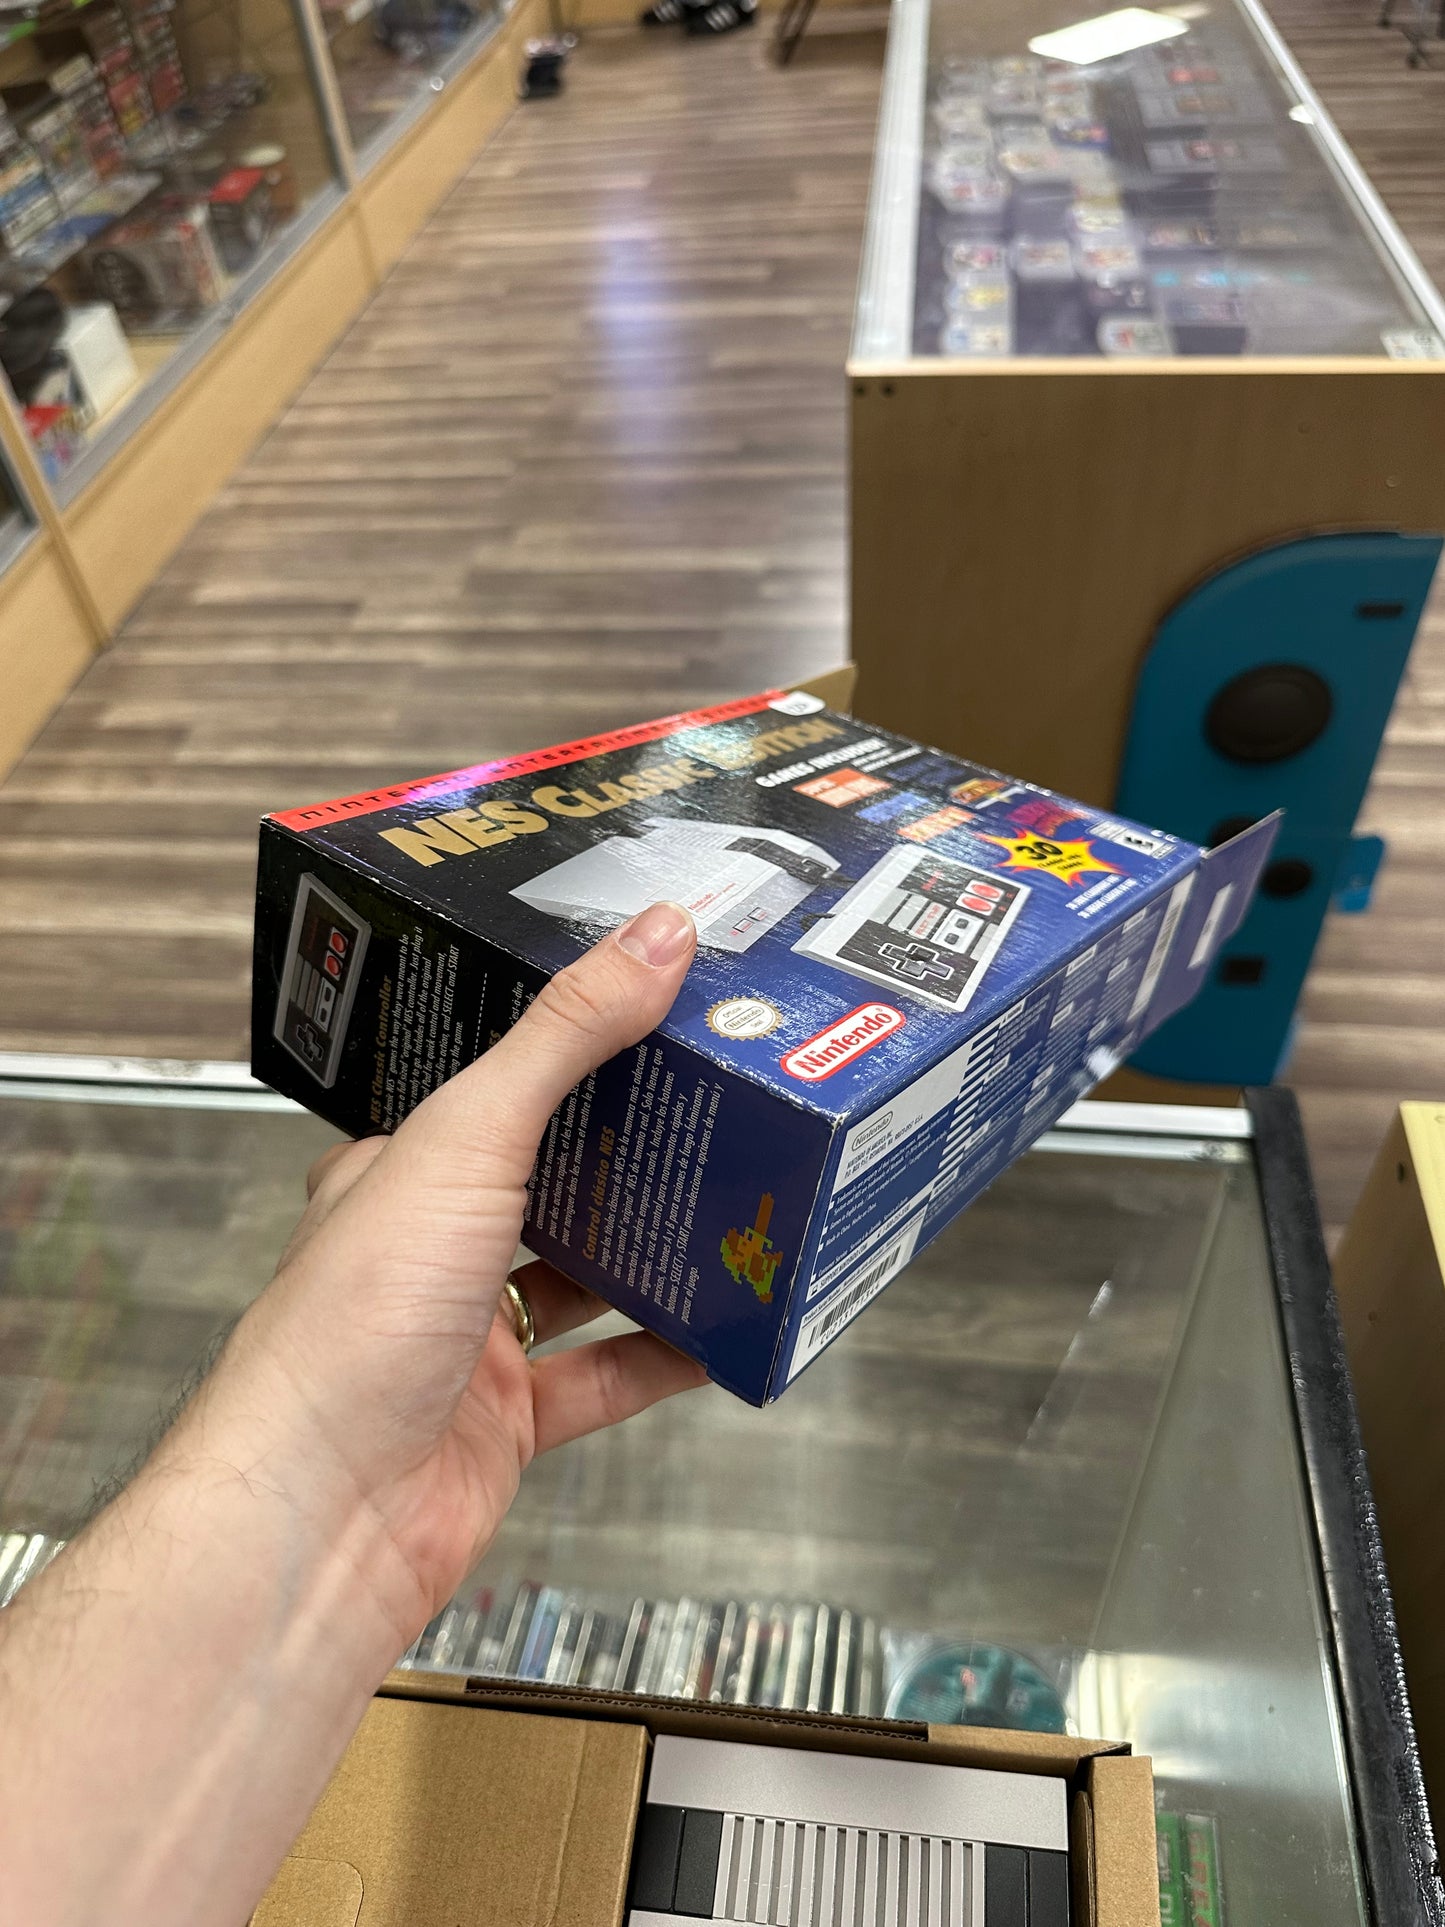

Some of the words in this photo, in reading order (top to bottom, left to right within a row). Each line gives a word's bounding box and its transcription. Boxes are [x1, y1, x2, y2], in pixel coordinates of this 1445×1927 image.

[379, 801, 549, 867] NES
[1015, 841, 1064, 861] 30
[398, 934, 409, 945] be
[399, 945, 407, 954] to
[410, 934, 423, 954] plug
[398, 954, 406, 980] meant
[409, 952, 419, 970] Just
[447, 944, 459, 970] START
[421, 956, 432, 988] original
[434, 952, 447, 997] movement,
[446, 968, 456, 987] and
[396, 981, 404, 1000] were
[407, 972, 417, 1008] controller.
[417, 989, 428, 1002] the
[442, 985, 453, 1014] SELECT
[376, 975, 391, 1047] Controller
[391, 1000, 403, 1018] they
[416, 1001, 426, 1012] of
[430, 993, 440, 1011] and
[392, 1018, 402, 1034] way
[403, 1007, 413, 1024] NES
[415, 1011, 425, 1024] all
[428, 1009, 438, 1038] control
[441, 1013, 450, 1030] and
[388, 1035, 398, 1048] the
[412, 1024, 424, 1054] Includes
[454, 1021, 463, 1045] game.
[425, 1038, 435, 1059] quick
[439, 1033, 450, 1057] action,
[449, 1044, 460, 1058] the
[389, 1049, 397, 1074] games
[422, 1059, 432, 1072] for
[632, 1044, 648, 1090] adecuada
[653, 1048, 663, 1065] que
[372, 1051, 385, 1095] Classic
[399, 1059, 408, 1081] sized
[411, 1068, 419, 1077] to
[421, 1070, 431, 1087] Pad
[646, 1066, 659, 1091] tienes
[396, 1079, 406, 1094] full
[409, 1077, 420, 1099] ready
[584, 1073, 595, 1093] jeu
[629, 1084, 639, 1103] más
[657, 1071, 674, 1104] botones
[383, 1093, 393, 1115] classic
[581, 1092, 592, 1101] le
[641, 1091, 654, 1110] Solo
[708, 1090, 720, 1116] menú
[370, 1097, 381, 1123] NES
[562, 1090, 576, 1127] boutons
[580, 1101, 590, 1128] mettre
[623, 1103, 635, 1135] manera
[654, 1104, 667, 1118] los
[670, 1101, 684, 1132] rápidos
[684, 1086, 704, 1131] fulminante
[638, 1111, 650, 1130] real.
[702, 1116, 714, 1128] de
[546, 1111, 559, 1164] mouvements
[560, 1127, 571, 1140] les
[577, 1127, 586, 1138] et
[599, 1126, 615, 1156] NES
[618, 1135, 629, 1145] la
[649, 1118, 665, 1147] Incluye
[561, 1139, 569, 1149] et
[574, 1138, 584, 1164] menus
[616, 1145, 627, 1156] de
[632, 1131, 646, 1162] tamaño
[678, 1132, 695, 1157] fuego
[697, 1129, 711, 1164] opciones
[556, 1152, 569, 1180] rapides,
[613, 1155, 625, 1173] NES
[628, 1162, 640, 1173] de
[646, 1150, 658, 1175] usarlo.
[661, 1132, 677, 1183] movimientos
[676, 1157, 688, 1169] de
[540, 1163, 551, 1178] des
[568, 1164, 580, 1176] les
[611, 1173, 622, 1184] de
[625, 1172, 637, 1190] NES
[541, 1177, 549, 1187] et
[552, 1179, 563, 1206] actions
[566, 1176, 578, 1195] dans
[591, 1159, 609, 1206] clásico
[673, 1169, 686, 1202] acciones
[686, 1165, 703, 1209] seleccionar
[639, 1183, 651, 1217] empezar
[657, 1183, 667, 1204] para
[536, 1187, 548, 1229] commandes
[548, 1205, 559, 1219] des
[563, 1195, 575, 1227] naviguer
[652, 1200, 663, 1229] control
[669, 1202, 679, 1223] para
[683, 1208, 693, 1230] para
[548, 1219, 557, 1239] pour
[561, 1227, 570, 1247] pour
[582, 1206, 601, 1259] Control
[617, 1225, 627, 1253] control
[632, 1217, 645, 1245] podrás
[646, 1229, 658, 1241] de
[676, 1226, 689, 1251] START
[600, 1235, 612, 1248] los
[646, 1240, 656, 1258] cruz
[598, 1247, 611, 1270] Juega
[615, 1253, 623, 1264] un
[627, 1250, 638, 1286] conectarlo
[655, 1243, 671, 1273] botones
[613, 1264, 621, 1278] con
[669, 1255, 683, 1285] SELECT
[685, 1266, 699, 1290] juego.
[653, 1275, 667, 1306] precisos,
[664, 1284, 678, 1313] botones
[682, 1285, 693, 1297] el
[681, 1296, 691, 1324] pausar
